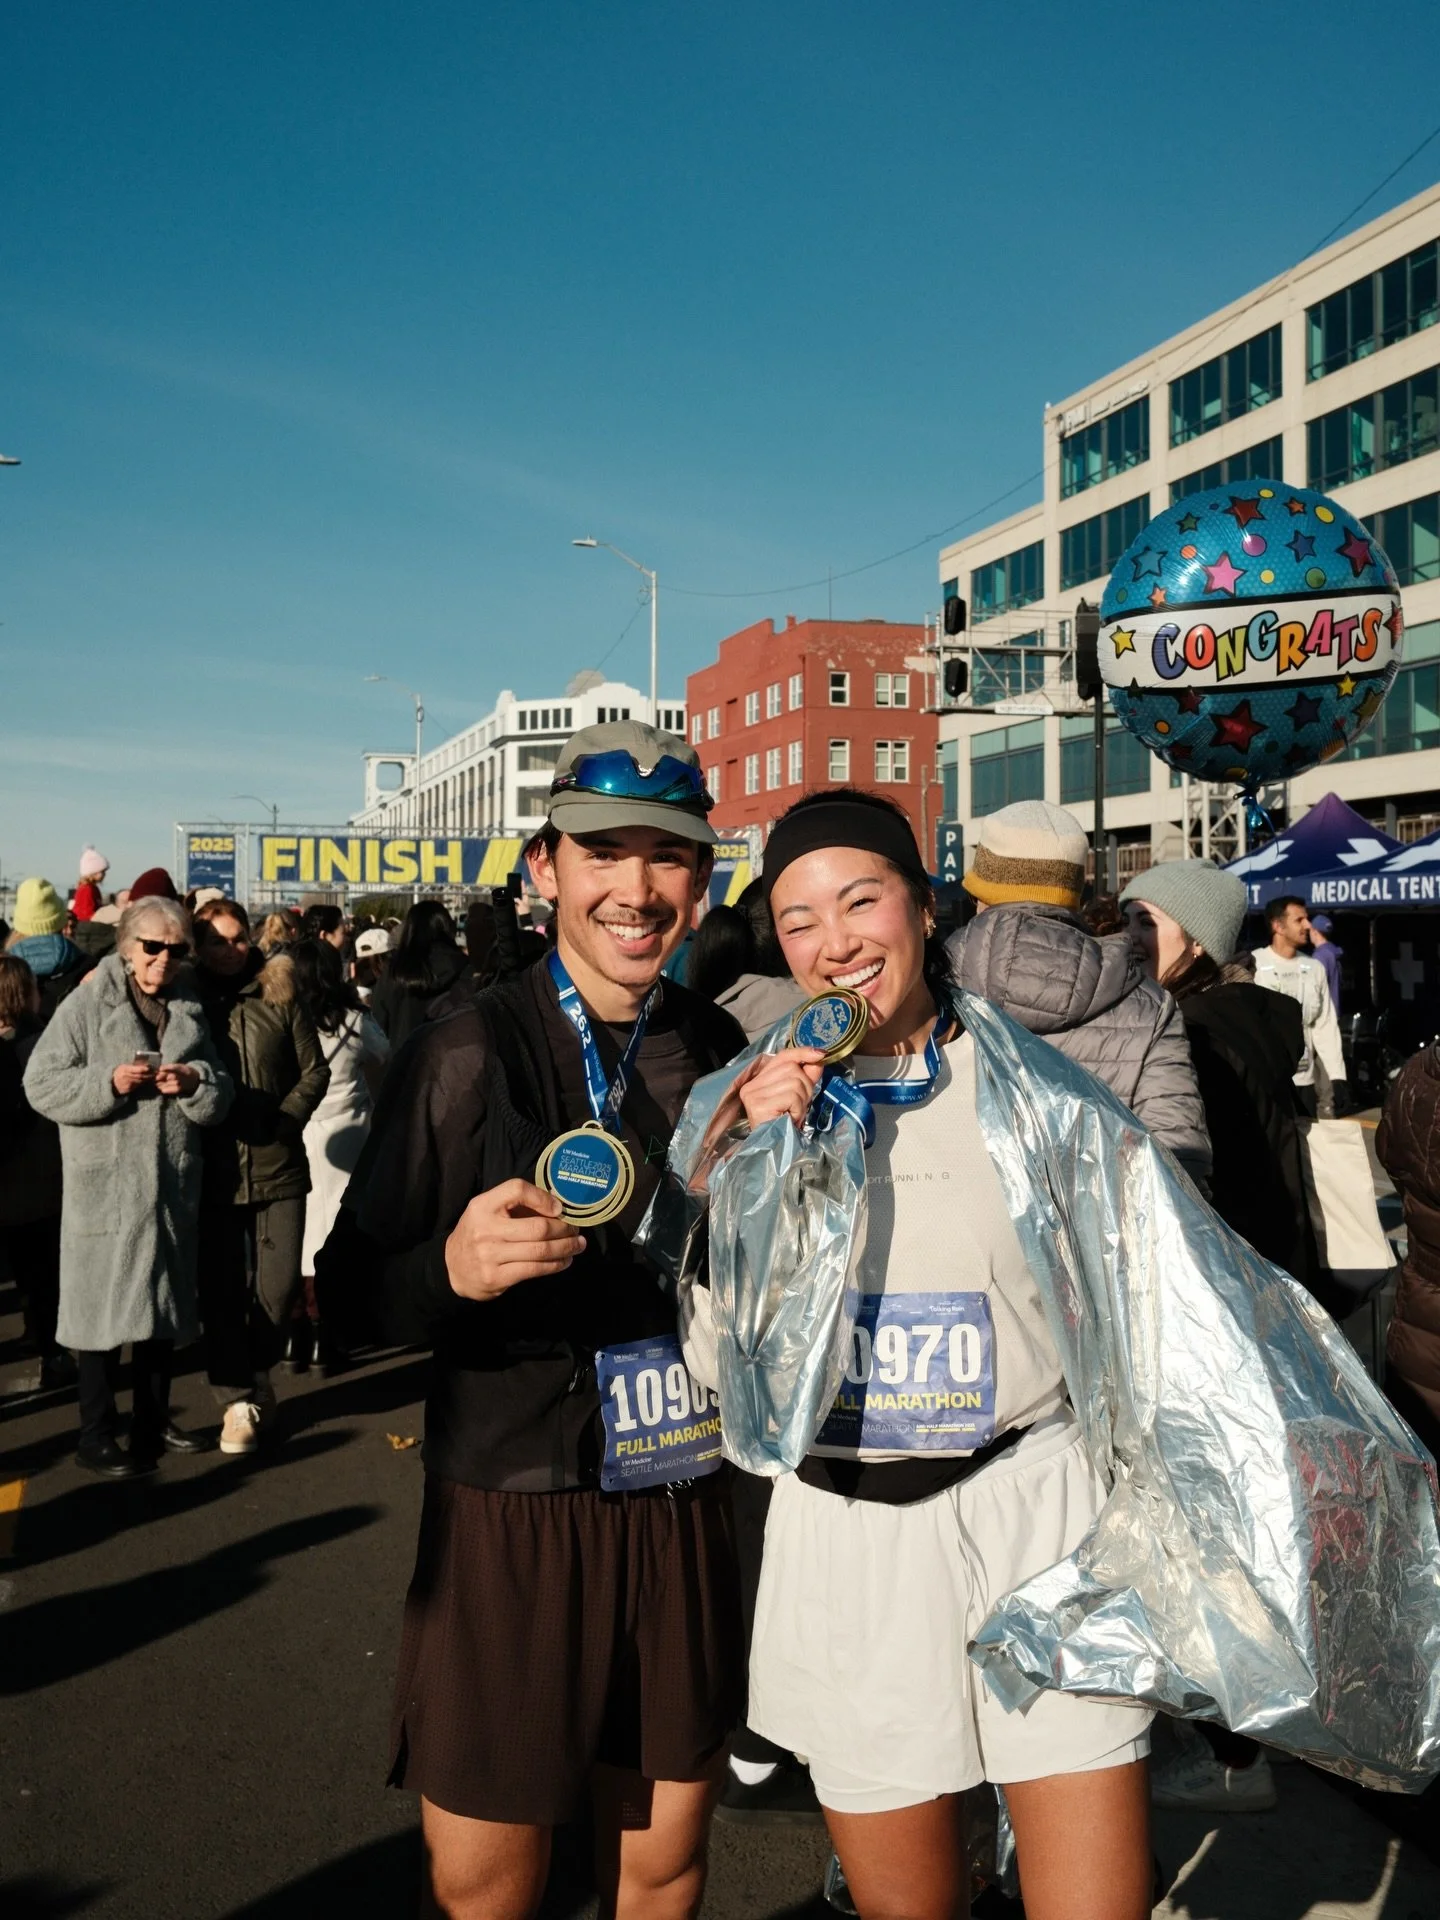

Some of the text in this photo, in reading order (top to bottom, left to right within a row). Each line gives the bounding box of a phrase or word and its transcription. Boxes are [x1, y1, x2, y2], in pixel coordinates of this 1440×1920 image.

[1151, 607, 1384, 682] CONGRATS
[190, 837, 234, 852] 2025
[262, 837, 463, 884] FINISH
[1312, 877, 1392, 903] MEDICAL
[569, 1001, 592, 1049] 26.2
[560, 1155, 594, 1169] SEATTLE
[559, 1163, 610, 1180] MARATHON
[581, 1179, 608, 1189] MARATHON
[865, 1391, 982, 1410] MARATHON
[862, 1423, 916, 1433] MARATHON
[616, 1441, 657, 1457] FULL
[620, 1454, 697, 1478] SEATTLE MARATHON
[631, 1457, 652, 1465] Medicine
